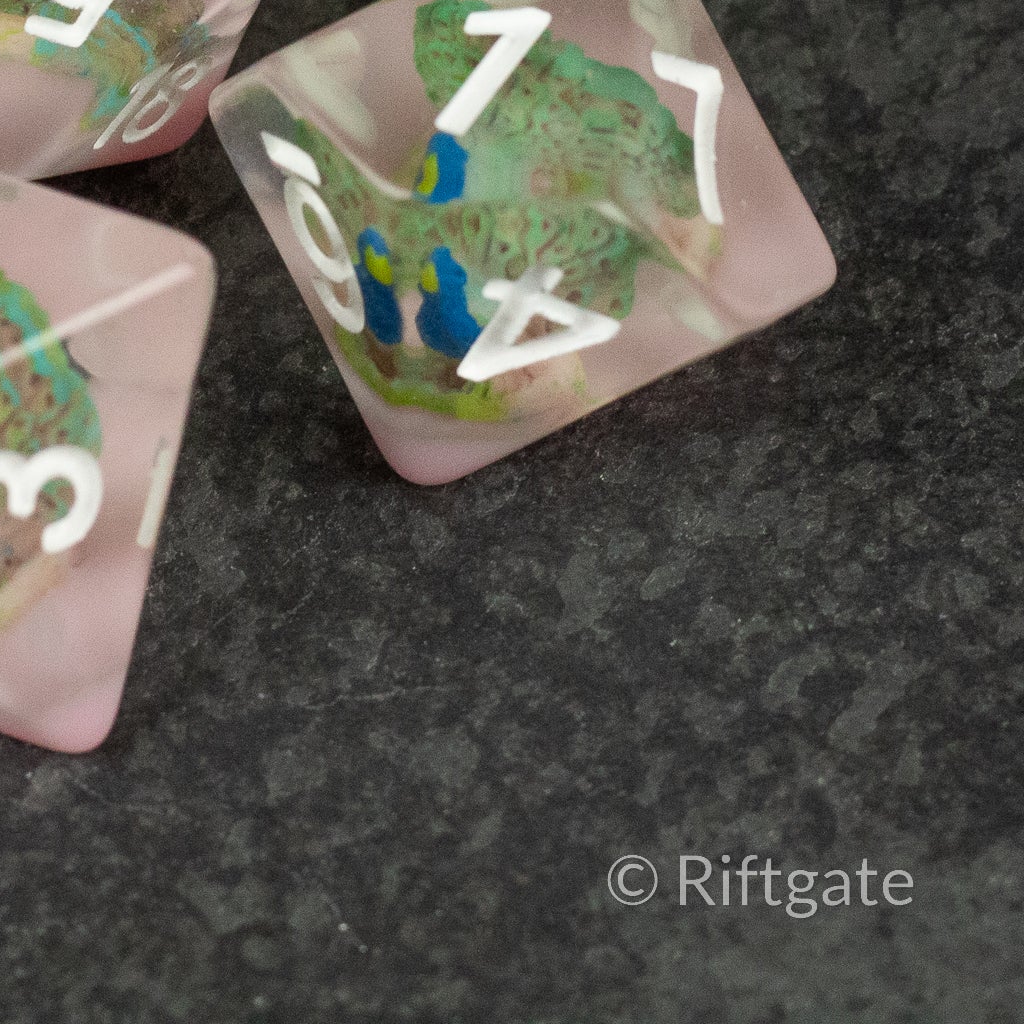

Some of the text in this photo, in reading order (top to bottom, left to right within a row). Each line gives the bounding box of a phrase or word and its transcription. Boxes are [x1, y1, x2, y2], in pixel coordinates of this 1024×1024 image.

[435, 7, 552, 136] 1
[652, 51, 725, 226] 7
[457, 267, 621, 382] 4
